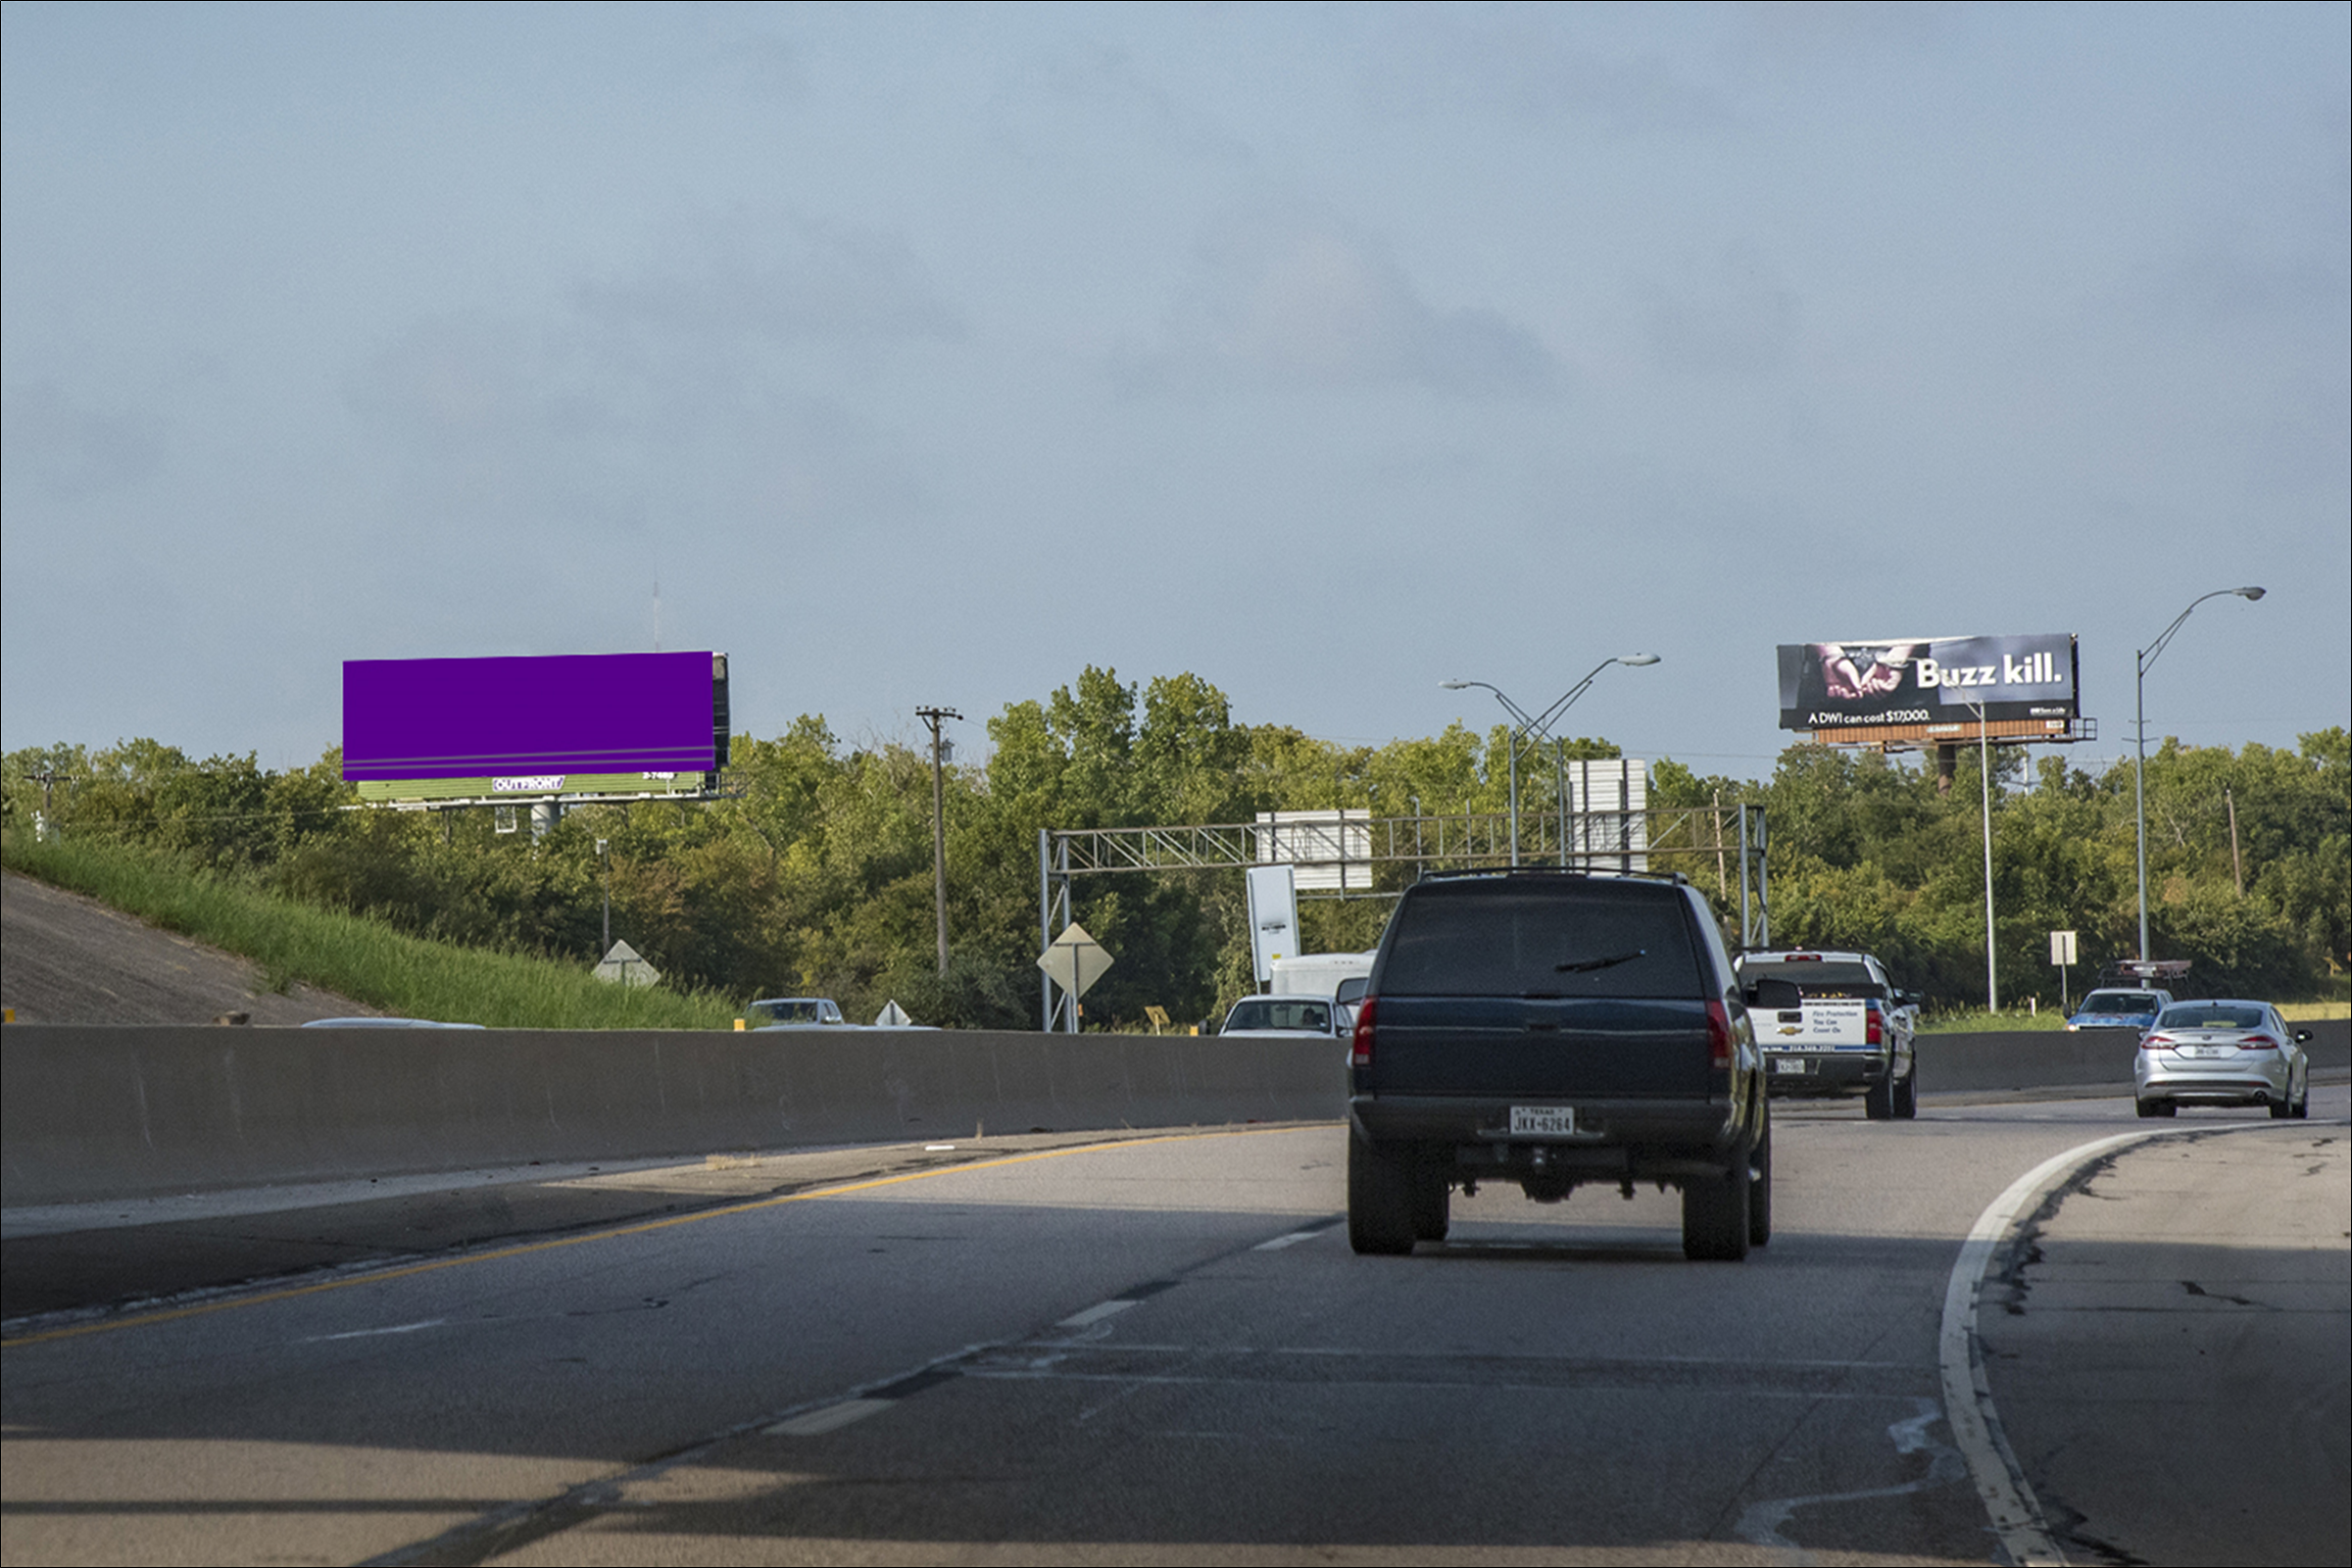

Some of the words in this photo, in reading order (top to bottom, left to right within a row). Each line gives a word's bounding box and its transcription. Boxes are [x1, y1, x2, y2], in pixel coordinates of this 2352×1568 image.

[1917, 658, 1996, 688] Buzz
[2003, 652, 2062, 684] kill.
[1808, 712, 1818, 723] A
[1819, 711, 1842, 723] DWI
[1843, 714, 1862, 723] can
[1863, 712, 1886, 723] cost
[494, 776, 564, 791] OUTFRONT
